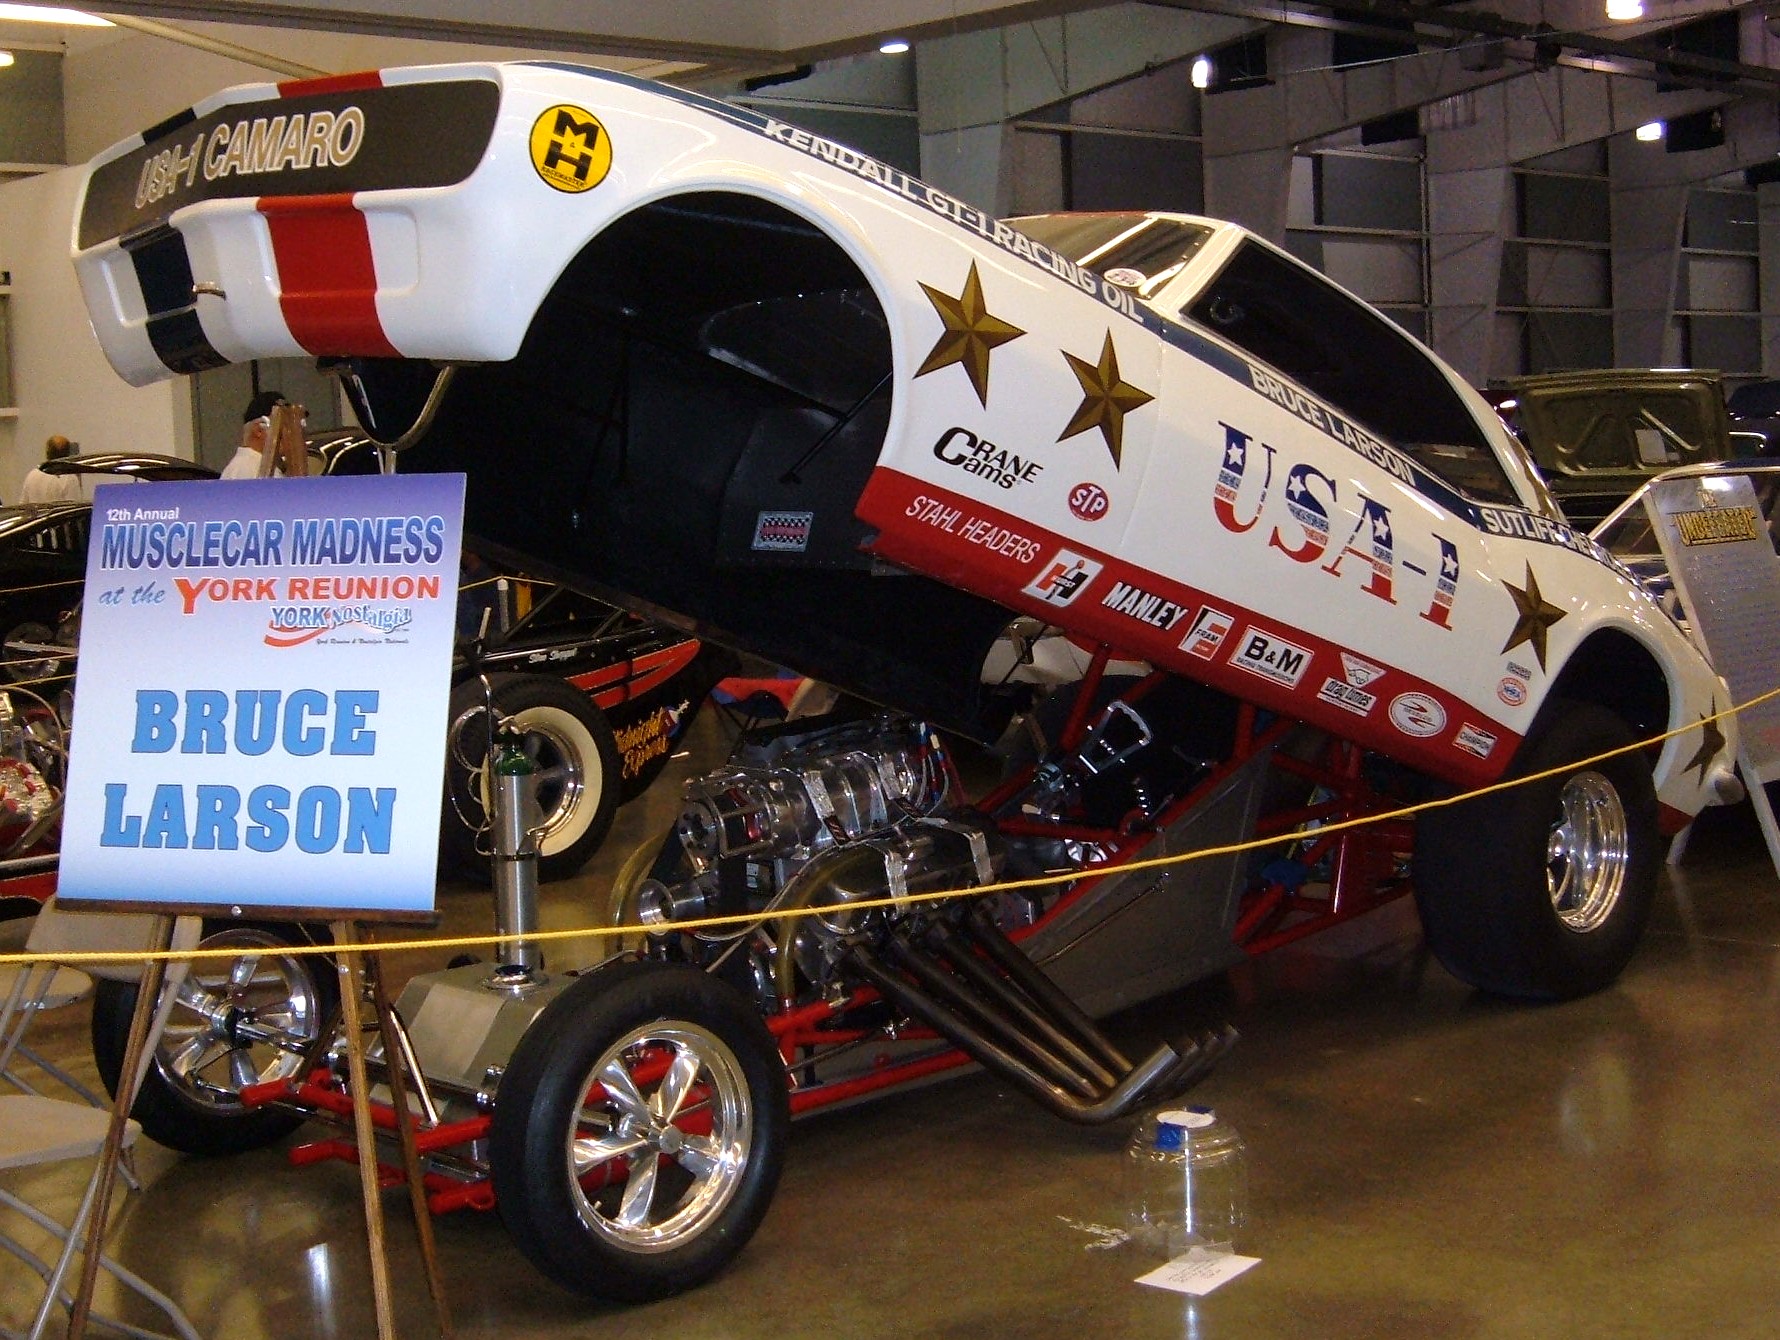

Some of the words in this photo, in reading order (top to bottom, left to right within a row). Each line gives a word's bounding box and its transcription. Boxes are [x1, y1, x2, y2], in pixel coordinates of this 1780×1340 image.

[135, 133, 204, 209] USA-1
[204, 107, 365, 181] CAMARO
[765, 119, 918, 200] KENDALL
[993, 220, 1096, 295] RACING
[1102, 282, 1144, 323] OIL
[1249, 364, 1325, 429] BRUCE
[1325, 411, 1416, 487] LARSON
[934, 427, 1043, 484] CRANE
[106, 508, 131, 521] 12th
[134, 507, 179, 520] Annual
[1071, 485, 1106, 513] STP
[1214, 420, 1459, 631] USA-1
[1480, 508, 1559, 542] SUTLIFF
[100, 520, 285, 571] MUSCLECAR
[291, 515, 445, 567] MADNESS
[905, 495, 962, 533] STAHL
[957, 516, 1041, 564] HEADERS
[99, 586, 124, 604] at
[132, 581, 166, 605] the
[173, 576, 279, 616] YORK
[288, 575, 441, 601] REUNION
[271, 605, 329, 629] YORK
[1102, 582, 1188, 630] MANLEY
[1195, 629, 1219, 642] FRAM
[1245, 635, 1304, 675] B&M
[131, 689, 379, 757] BRUCE
[100, 783, 397, 855] LARSON
